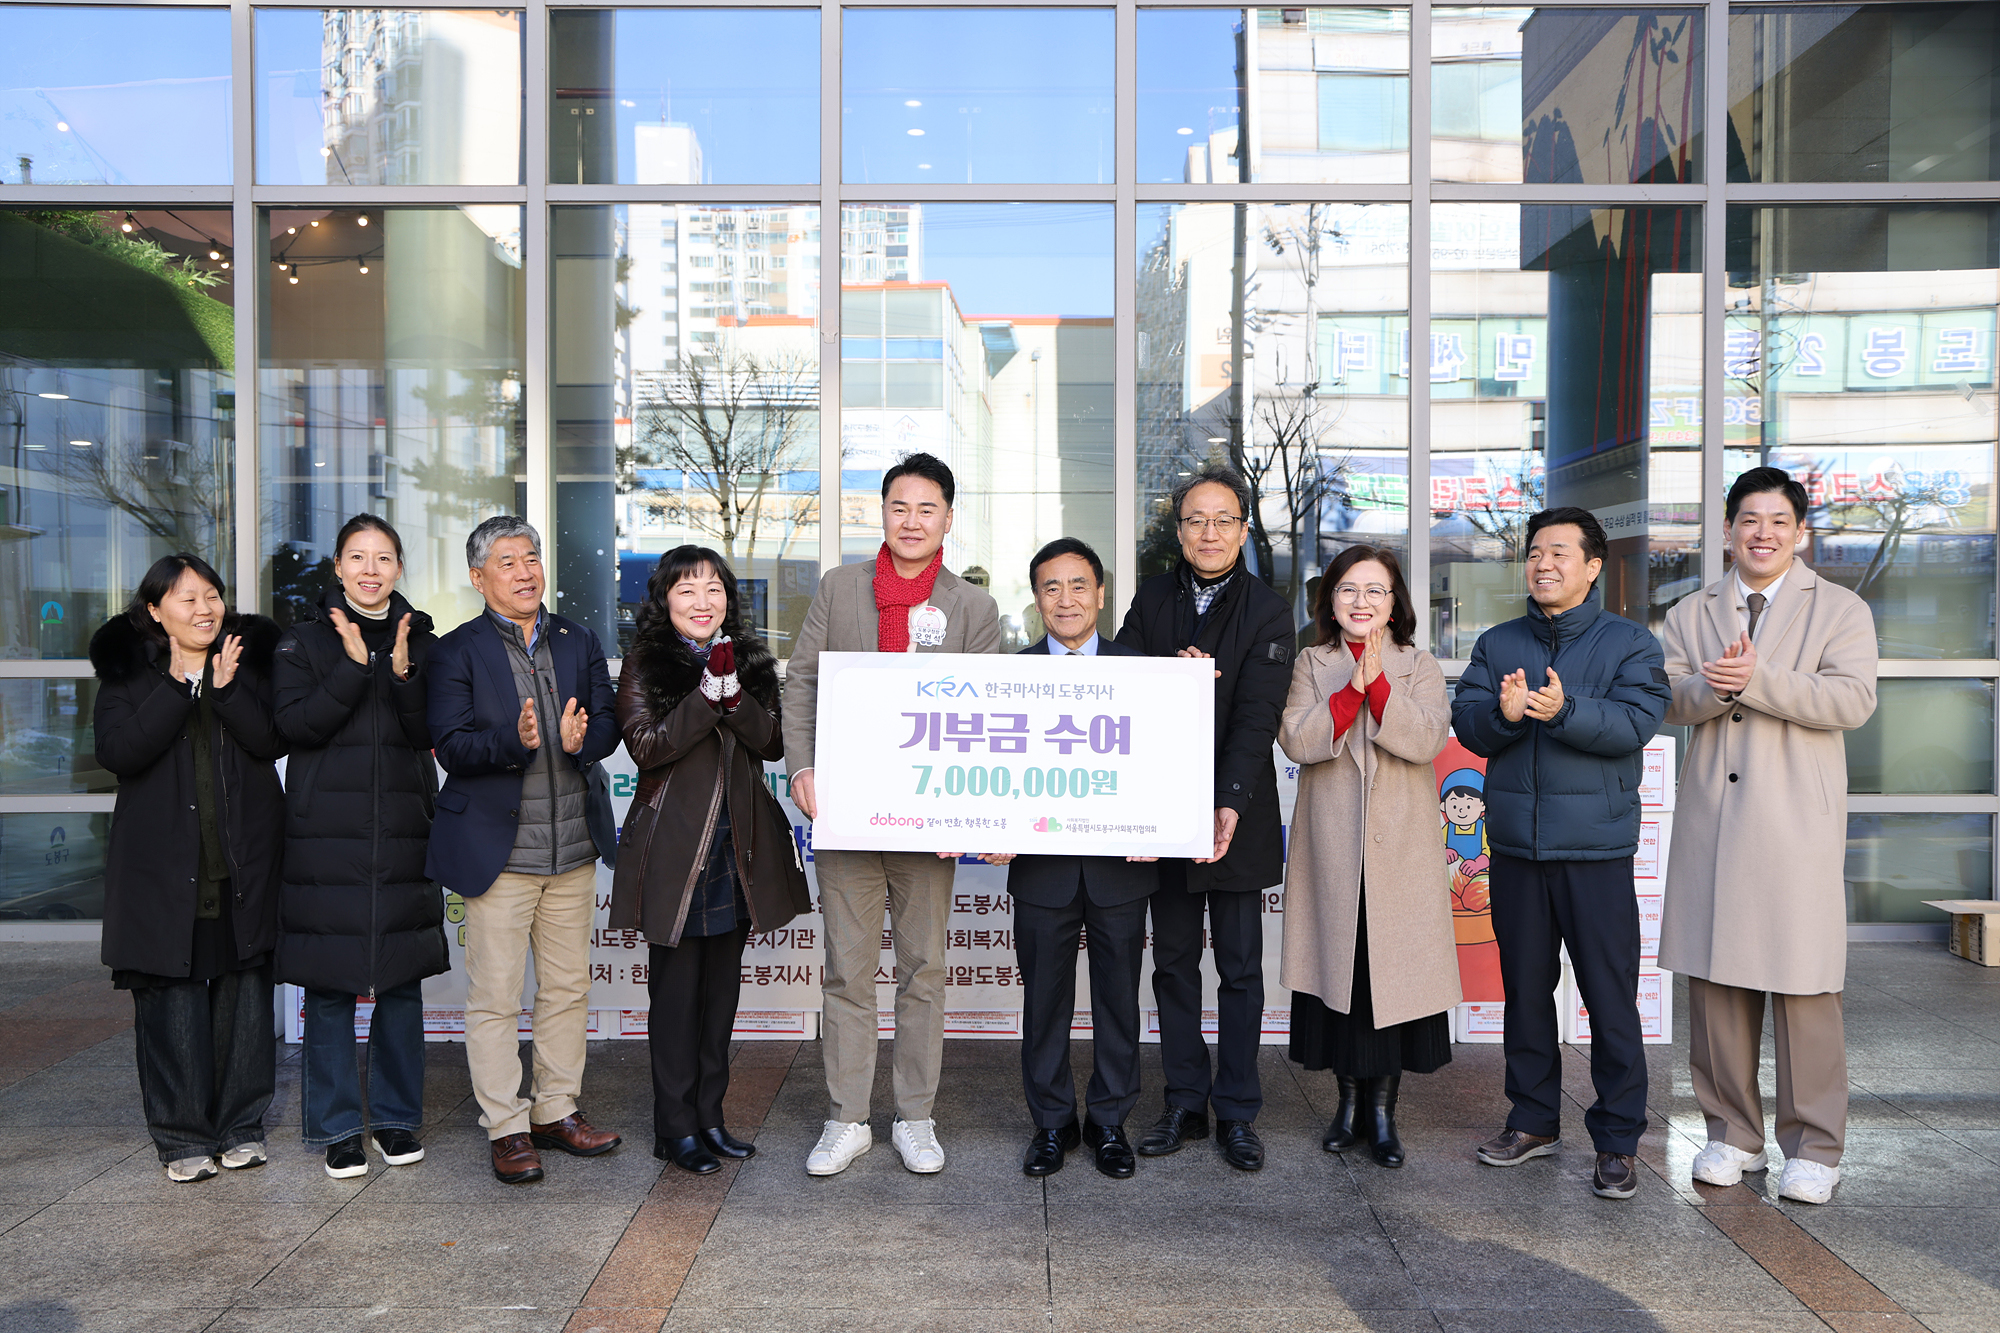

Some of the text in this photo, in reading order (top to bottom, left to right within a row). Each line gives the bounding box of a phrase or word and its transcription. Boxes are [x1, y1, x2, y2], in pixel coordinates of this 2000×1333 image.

[917, 675, 1115, 702] KRA 한국마사회 도봉지사
[899, 712, 1131, 755] 기부금 수여
[911, 764, 1118, 799] 7,000,000원
[870, 812, 924, 830] dobong
[927, 817, 942, 827] 같이
[965, 817, 991, 828] 행복한
[993, 818, 1007, 829] 도봉
[1065, 823, 1157, 834] 서울특별시도봉구사회복지협의회
[45, 848, 70, 866] 도봉구
